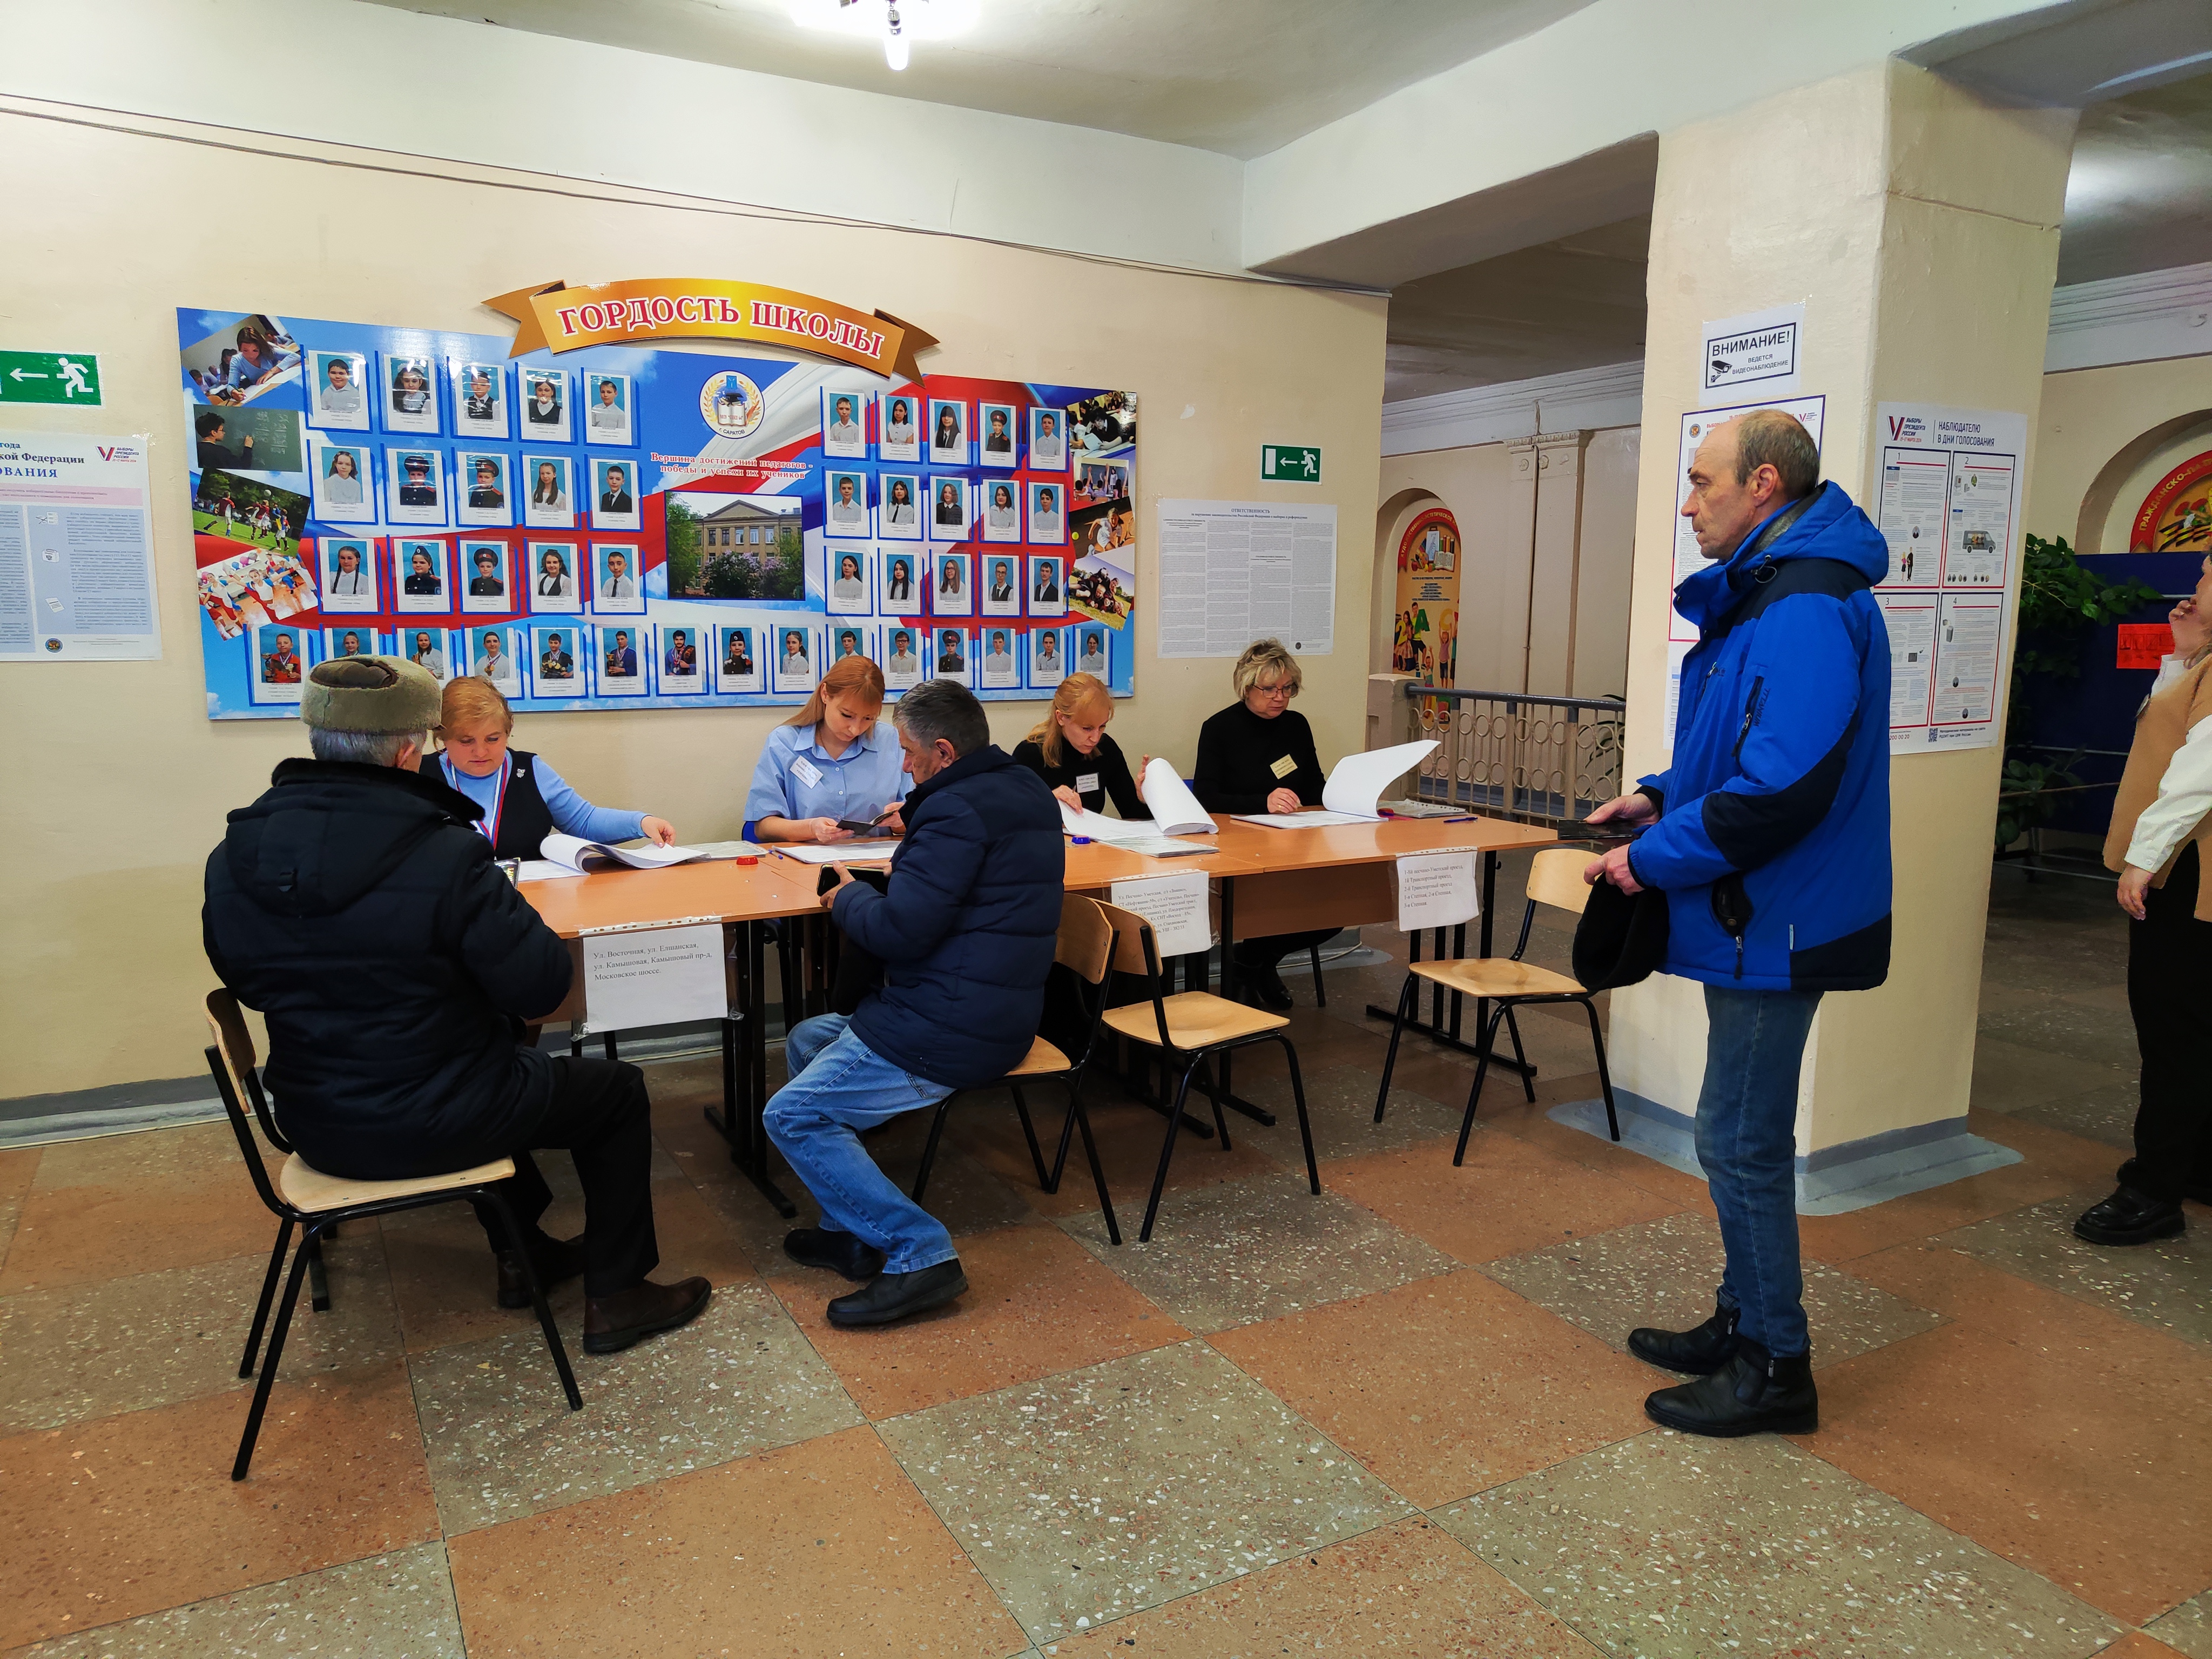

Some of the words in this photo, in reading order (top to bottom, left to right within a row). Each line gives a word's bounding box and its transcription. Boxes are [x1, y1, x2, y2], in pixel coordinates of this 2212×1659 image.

[557, 295, 740, 336] ГОРДОСТЬ
[750, 300, 885, 360] ШКОЛЫ
[1712, 331, 1790, 356] ВНИМАНИЕ!
[1748, 354, 1773, 363] ВЕДЕТСЯ
[1732, 360, 1789, 375] ВИДЕОНАБЛЮДЕНИЕ
[1938, 421, 1981, 433] НАБЛЮДАТЕЛЮ
[1938, 434, 1941, 443] В
[1942, 435, 1954, 444] ДНИ
[1955, 436, 1995, 447] ГОЛОСОВАНИЯ
[22, 453, 85, 464] Федерации
[651, 453, 696, 463] Вершина
[699, 457, 757, 466] достижений
[760, 460, 806, 469] педагогов
[1897, 452, 1900, 460] 1
[1965, 457, 1969, 465] 2
[660, 464, 697, 474] победы
[710, 468, 744, 476] успехи
[761, 470, 805, 479] учеников
[1885, 597, 1890, 605] 3
[1953, 597, 1957, 605] 4
[608, 947, 646, 958] Восточная,
[647, 946, 658, 955] ул.
[659, 942, 699, 952] Елшанская,
[594, 963, 605, 972] ул.
[606, 958, 649, 969] Камышовая,
[651, 953, 694, 963] Камышовый
[695, 952, 713, 961] пр-д,
[595, 970, 637, 981] Московское
[638, 968, 662, 976] шоссе.
